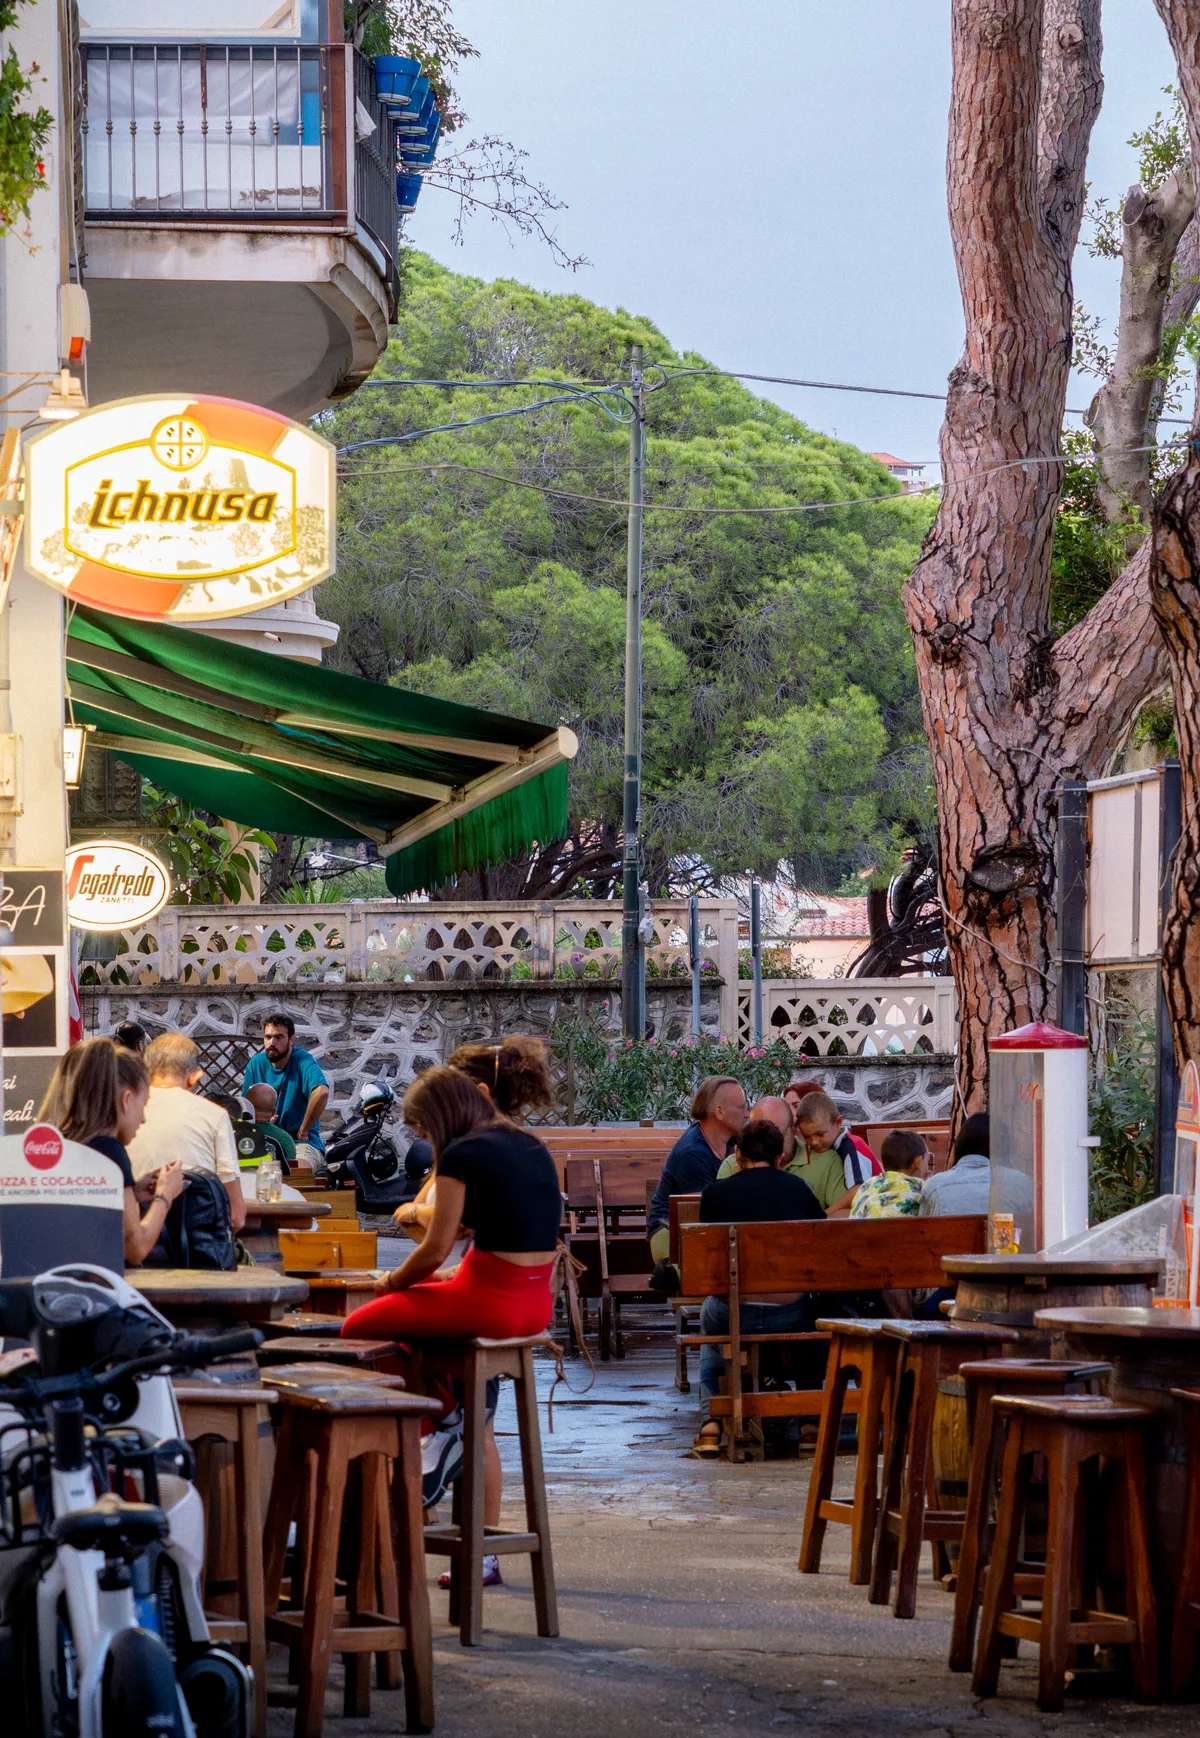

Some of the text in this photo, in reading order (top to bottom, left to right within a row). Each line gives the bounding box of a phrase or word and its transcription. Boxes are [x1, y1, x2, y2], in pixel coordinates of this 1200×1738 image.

[88, 479, 279, 529] ichnusa
[68, 855, 156, 901] Segafredo
[100, 896, 134, 904] ZANETTI
[30, 1177, 37, 1186] E
[41, 1176, 107, 1186] COCA-COLA
